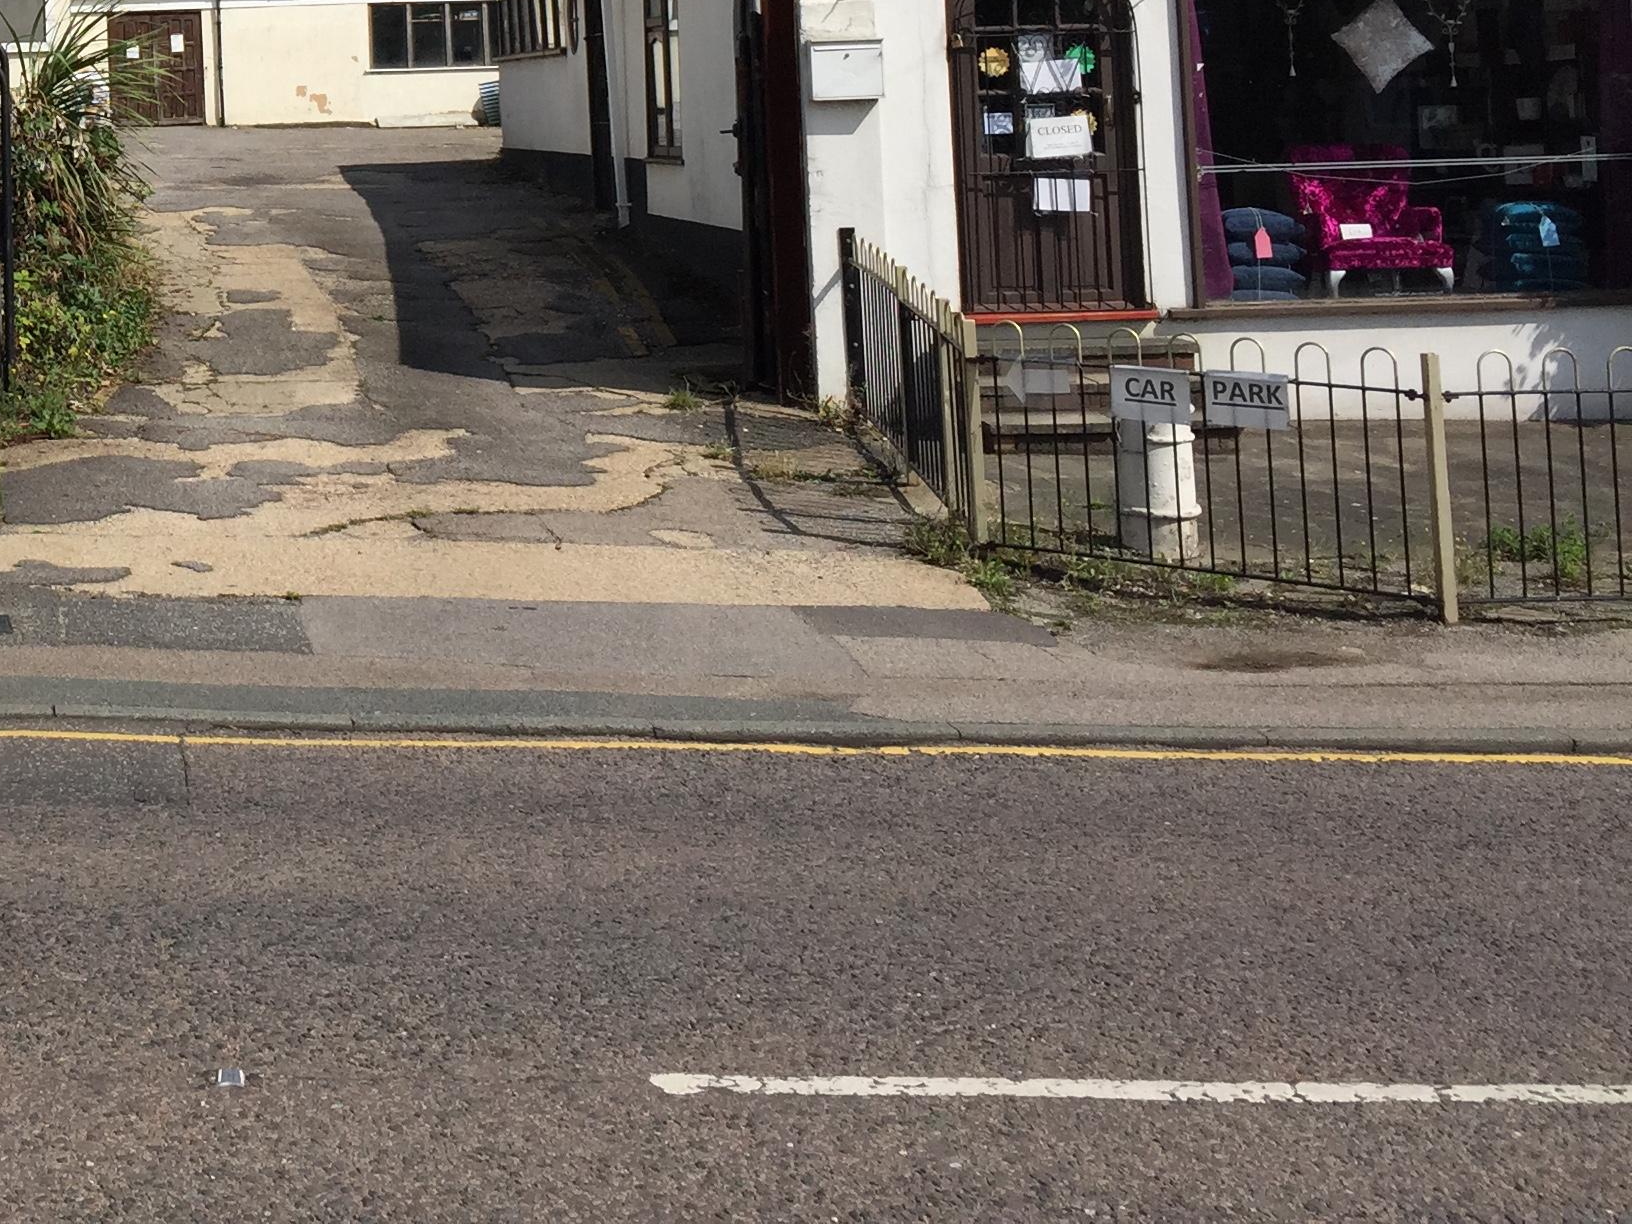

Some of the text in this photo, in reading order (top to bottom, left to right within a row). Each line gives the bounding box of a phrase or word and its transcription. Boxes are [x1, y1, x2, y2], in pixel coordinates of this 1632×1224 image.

[1037, 124, 1083, 136] CLOSED
[1125, 377, 1283, 405] CAR PARK
